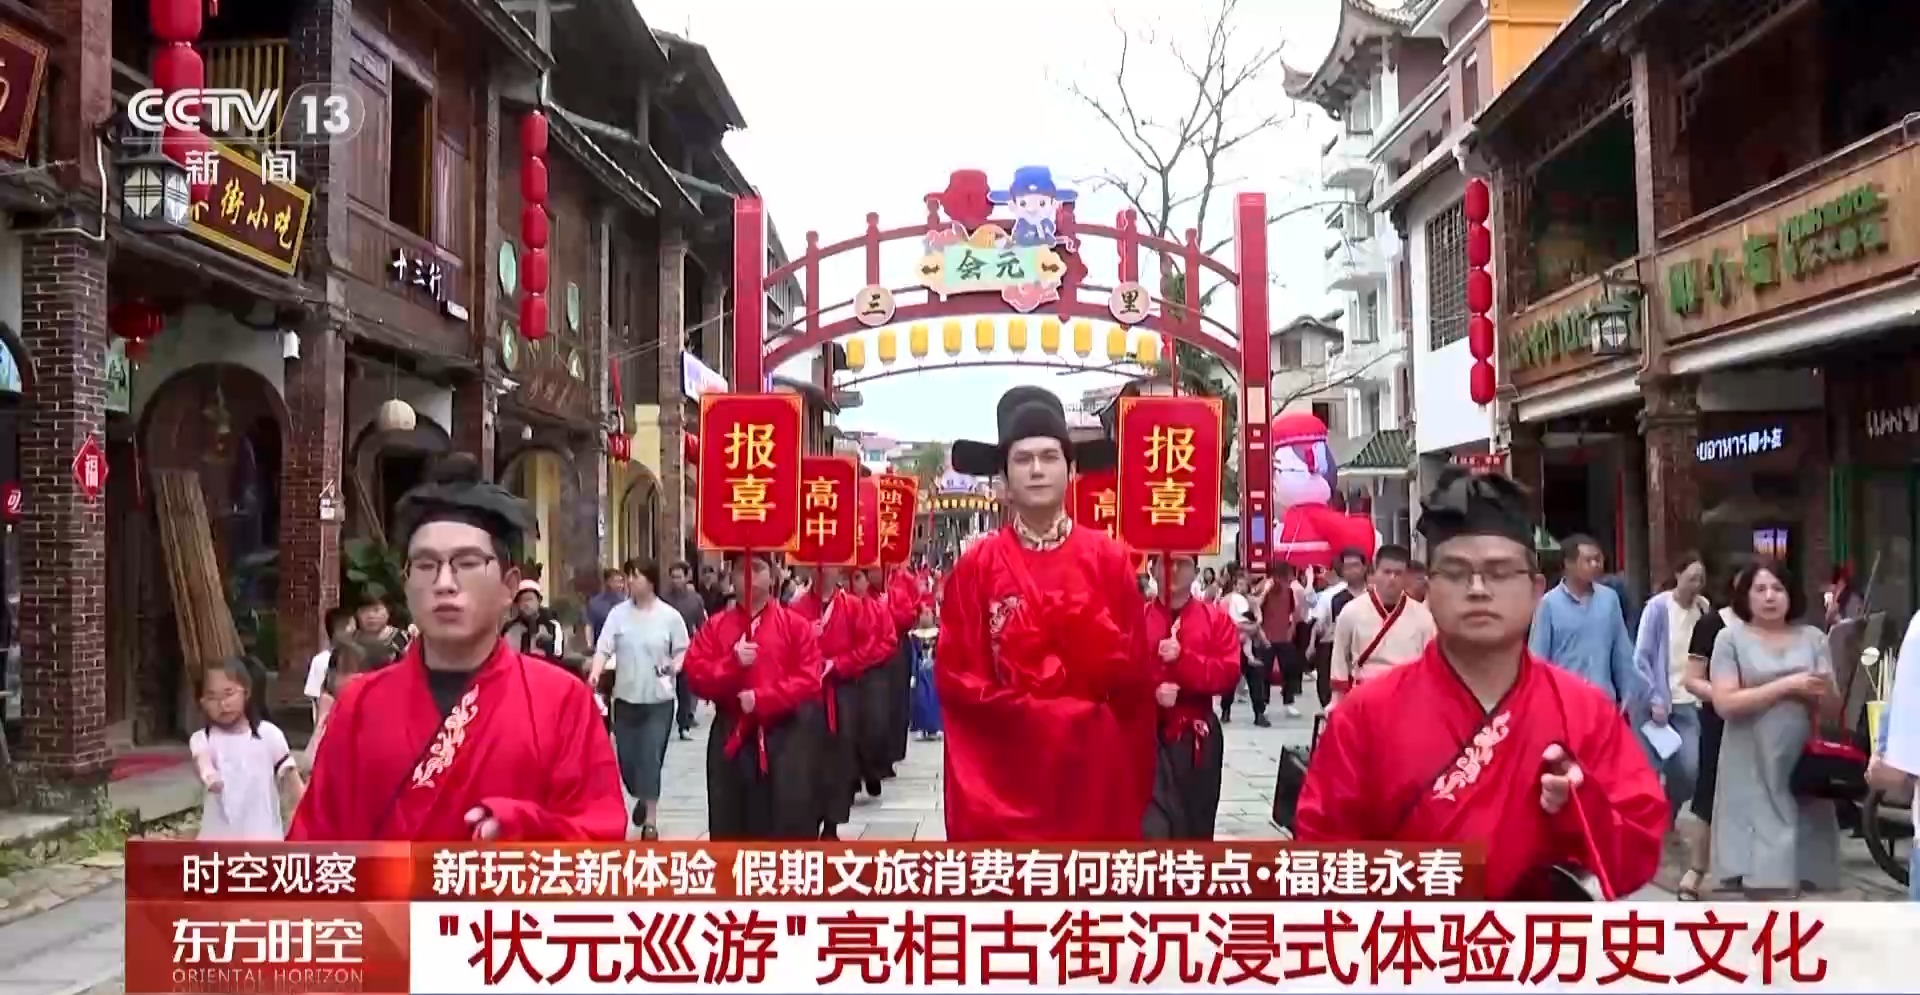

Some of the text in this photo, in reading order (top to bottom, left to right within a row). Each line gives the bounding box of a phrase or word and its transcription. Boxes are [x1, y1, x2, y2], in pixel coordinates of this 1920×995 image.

[393, 247, 443, 301] 十三行
[957, 249, 1026, 281] 会元
[724, 421, 776, 524] 报喜
[1143, 424, 1196, 526] 报喜
[804, 475, 840, 546] 高中
